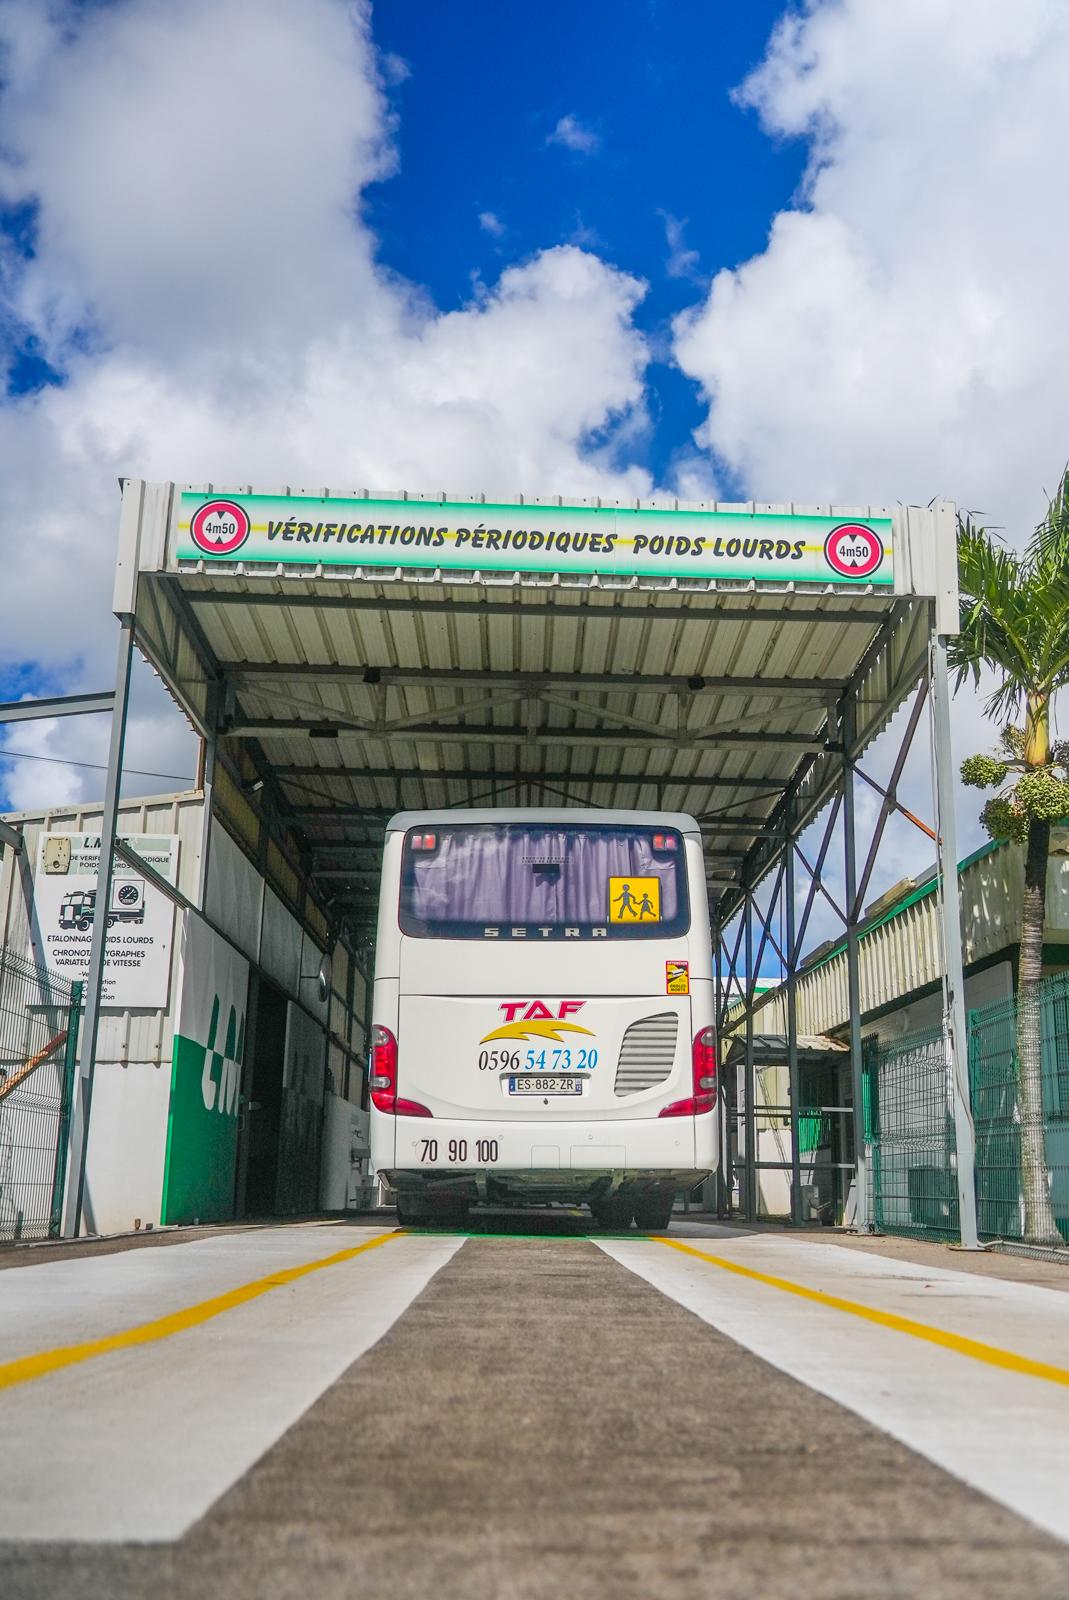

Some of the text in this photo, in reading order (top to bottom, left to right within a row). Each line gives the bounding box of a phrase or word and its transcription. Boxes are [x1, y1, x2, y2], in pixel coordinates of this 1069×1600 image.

[205, 522, 236, 535] 4m50
[267, 517, 806, 561] VÉRIFICATIONS PÉRIODIQUES POIDS LOURDS
[839, 545, 869, 558] 4m50
[484, 927, 608, 937] SETRA
[47, 935, 92, 943] ETALONNAG
[123, 936, 154, 944] LOURDS
[52, 949, 146, 958] CHRONOTYGRAPHES
[55, 958, 91, 966] VARIATEU
[498, 1000, 588, 1023] TAF
[478, 1048, 599, 1071] 0596 54 73 20
[517, 1079, 574, 1090] ES-882-ZR
[420, 1139, 499, 1162] 70 90 100
